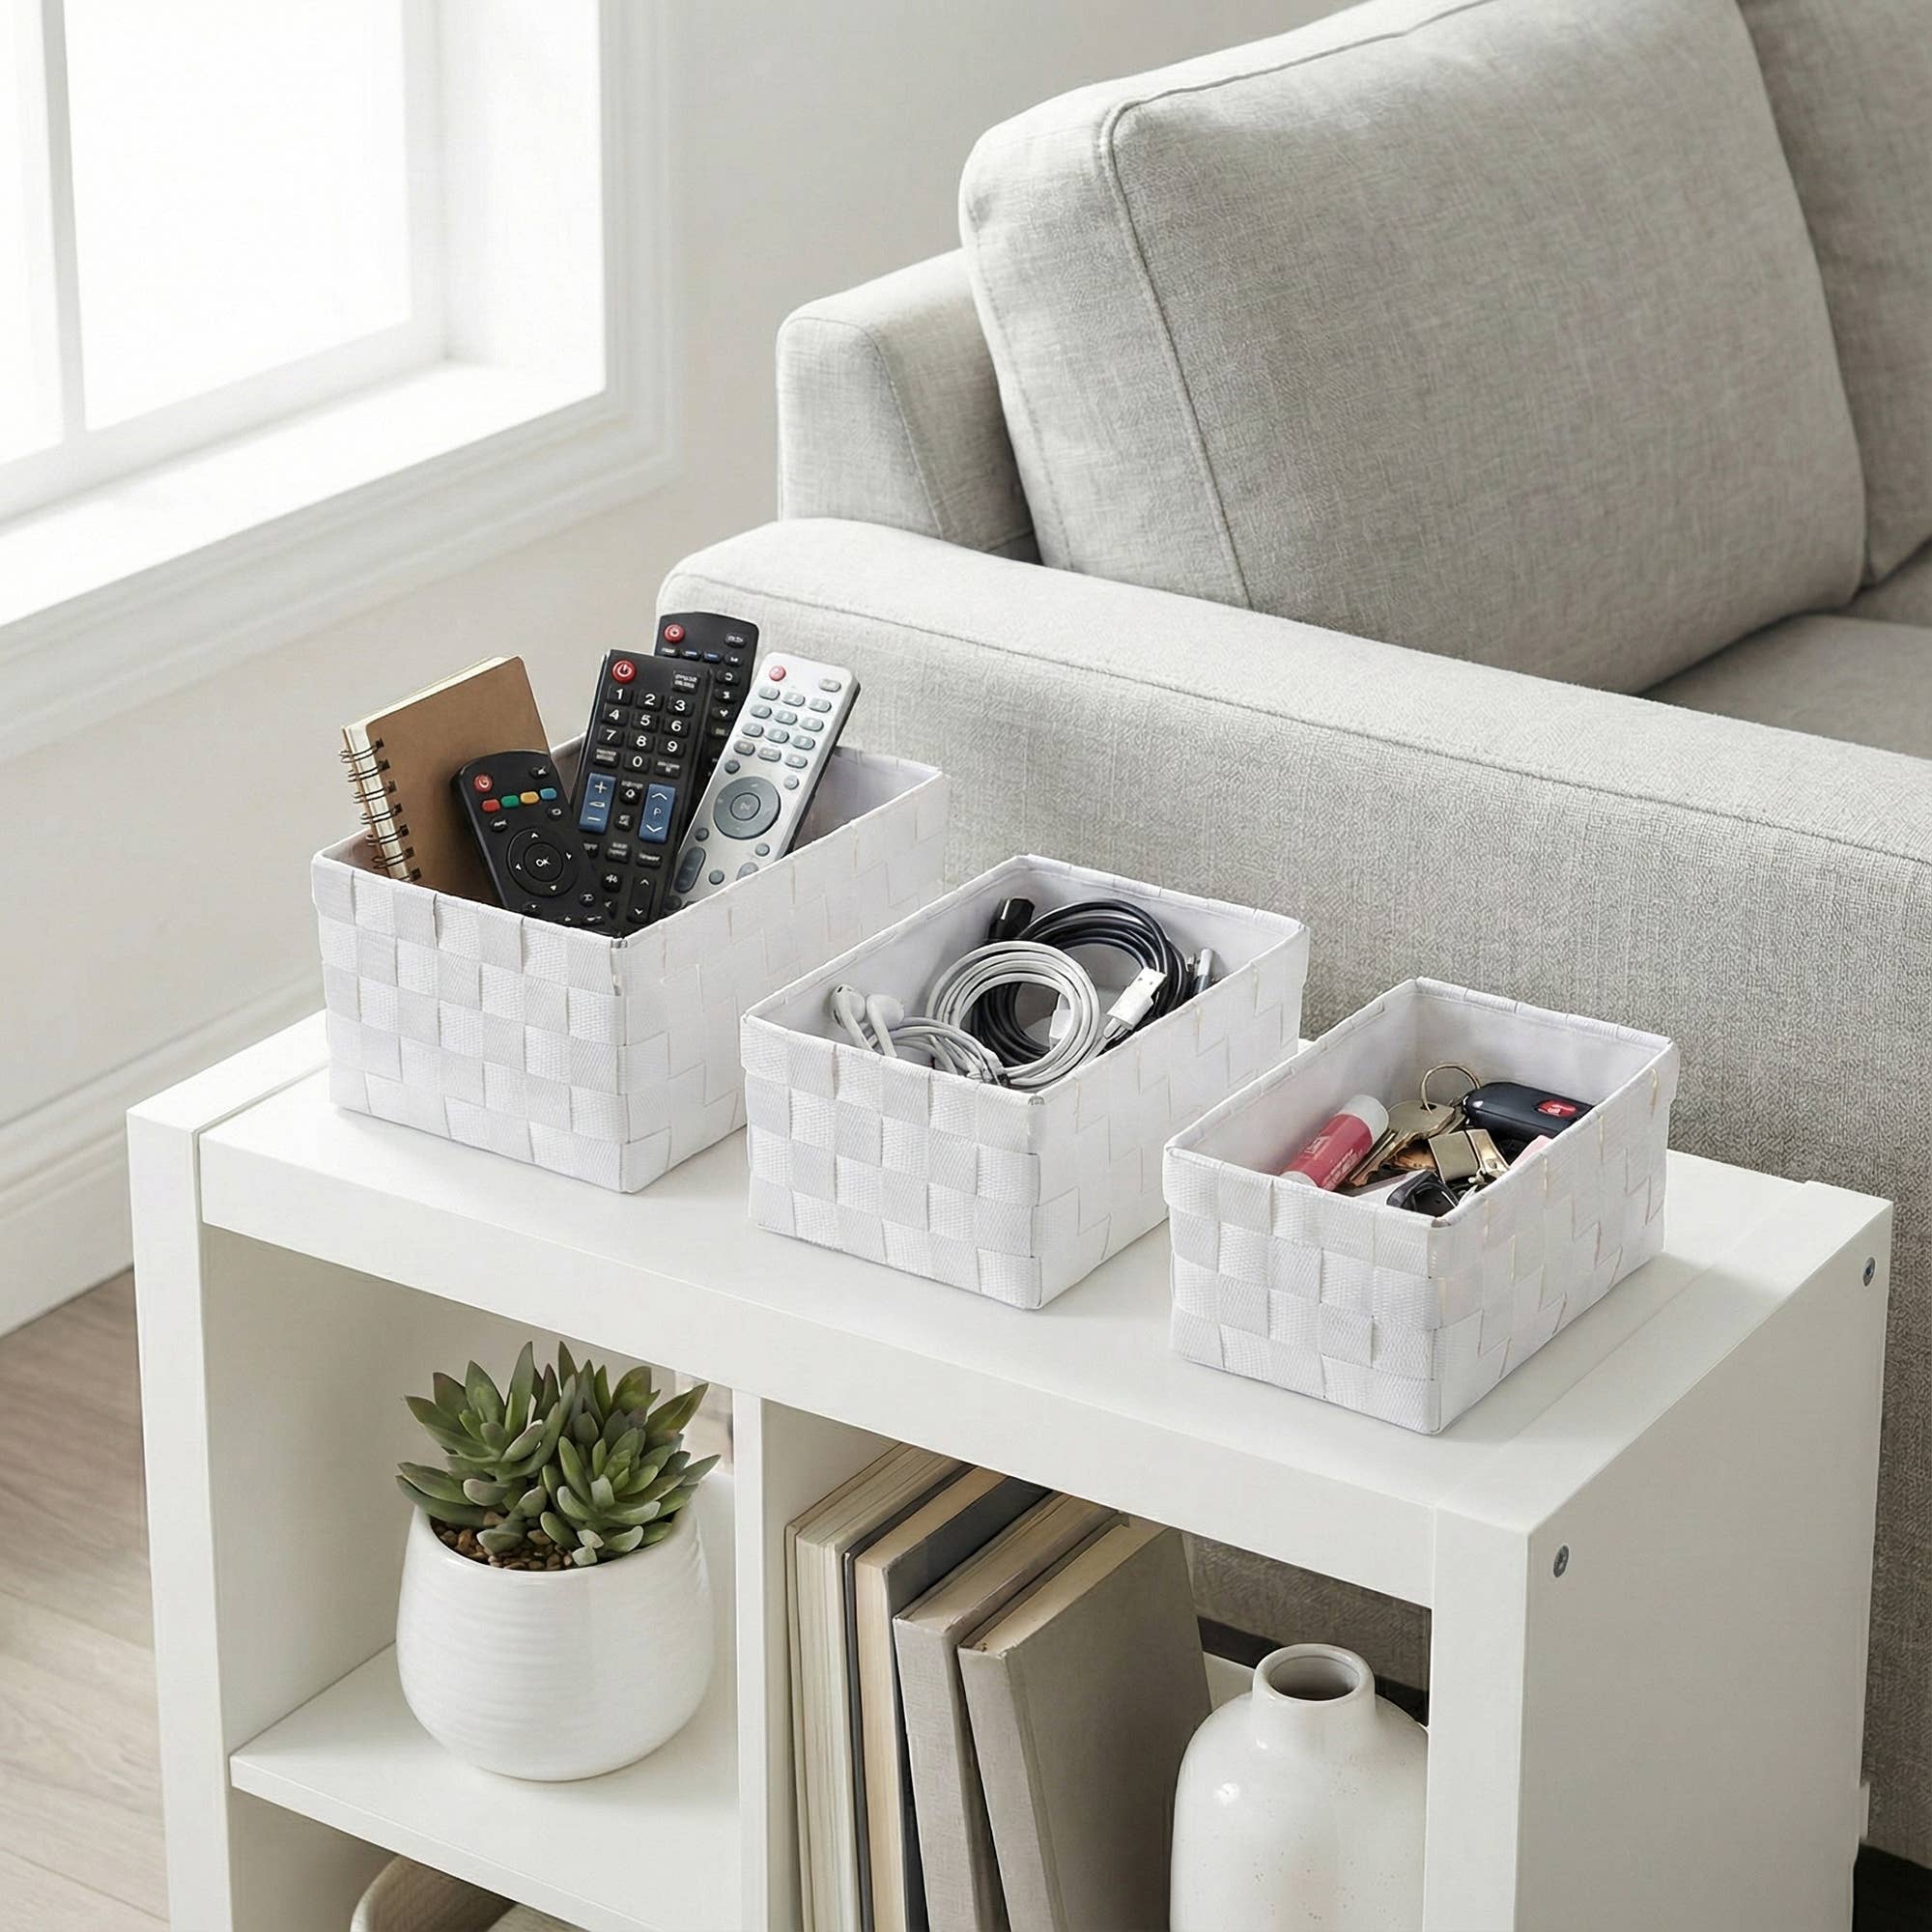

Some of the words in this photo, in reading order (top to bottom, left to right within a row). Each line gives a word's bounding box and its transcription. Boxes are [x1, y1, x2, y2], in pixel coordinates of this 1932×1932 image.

[616, 688, 624, 700] 1
[644, 694, 656, 706] 2
[674, 699, 686, 711] 3
[609, 709, 619, 721] 4
[639, 714, 651, 726] 5
[670, 720, 682, 732] 6
[606, 728, 616, 741] 7
[636, 735, 647, 747] 8
[667, 740, 678, 753] 9
[632, 755, 643, 768] 0
[653, 807, 662, 816] P
[535, 857, 551, 867] OK
